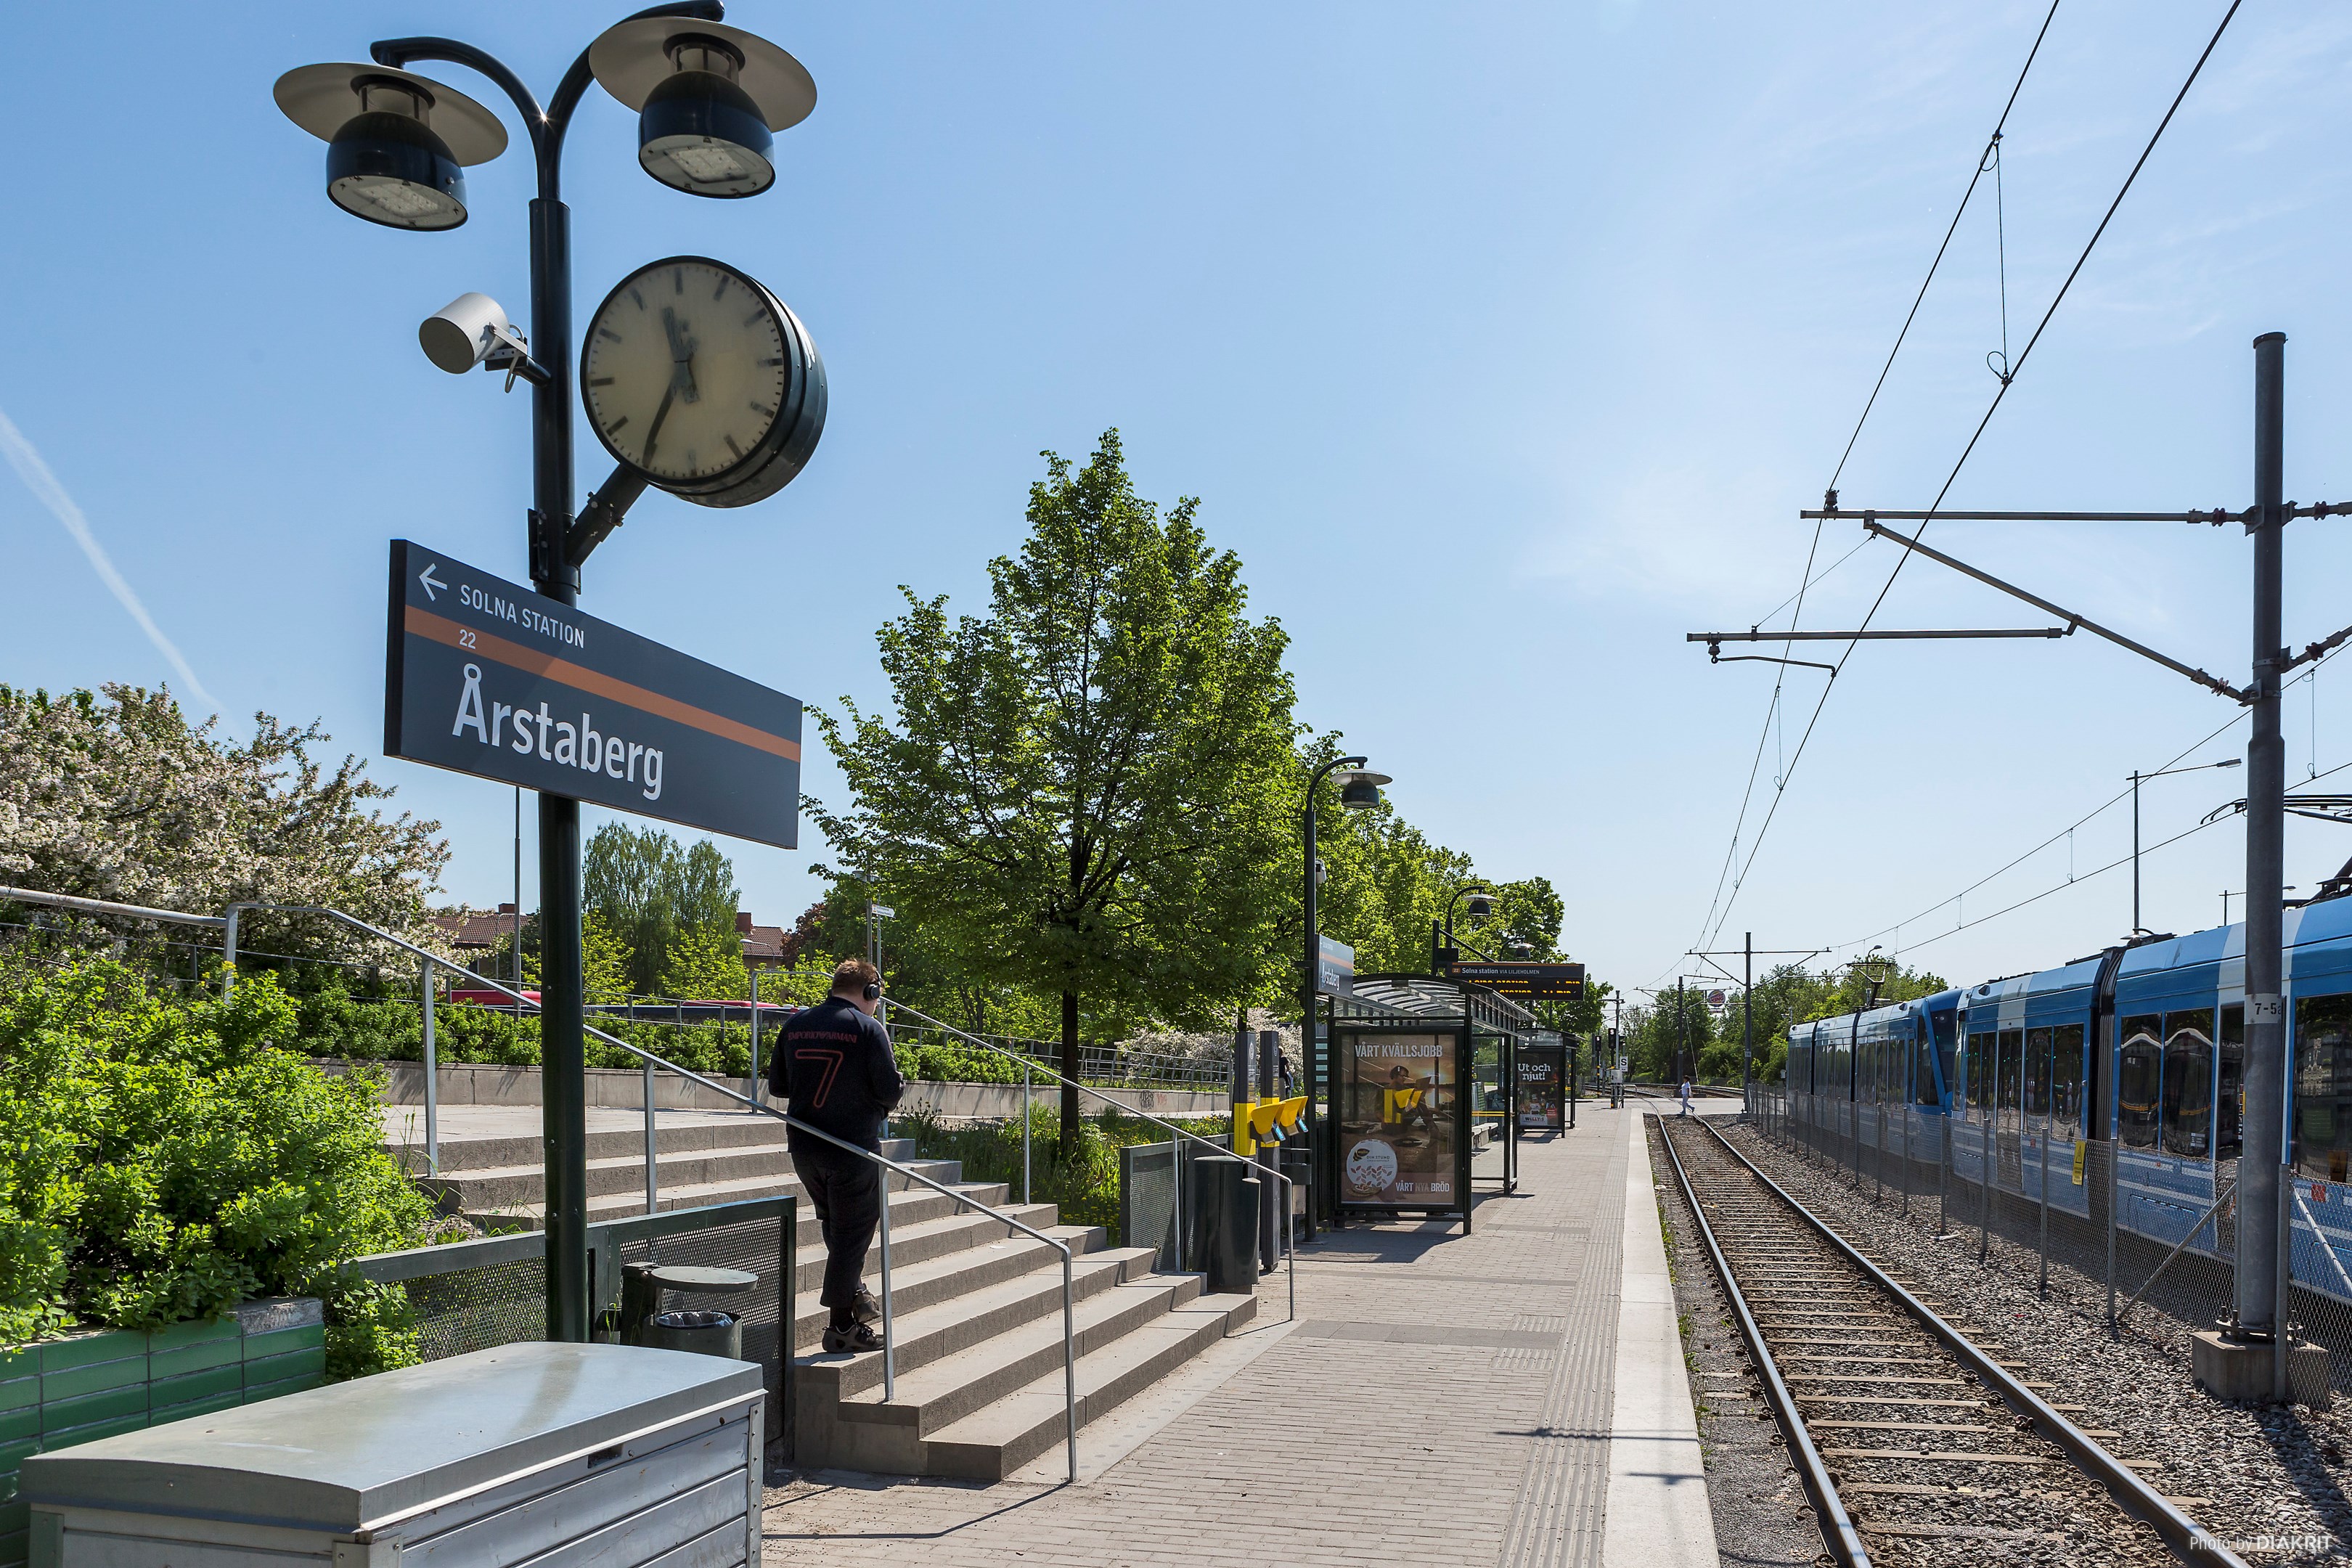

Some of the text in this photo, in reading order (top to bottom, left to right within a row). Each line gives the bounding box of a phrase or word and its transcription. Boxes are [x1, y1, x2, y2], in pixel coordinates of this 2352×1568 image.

[460, 584, 584, 649] SOLNA STATION
[459, 629, 476, 650] 22
[452, 663, 663, 801] Årstaberg
[1355, 1042, 1443, 1057] VÅRT KVÄLLSJOBB
[794, 1049, 844, 1108] 7
[1522, 1071, 1545, 1082] njut!
[1395, 1180, 1450, 1192] VÅRT NYA BRÖD
